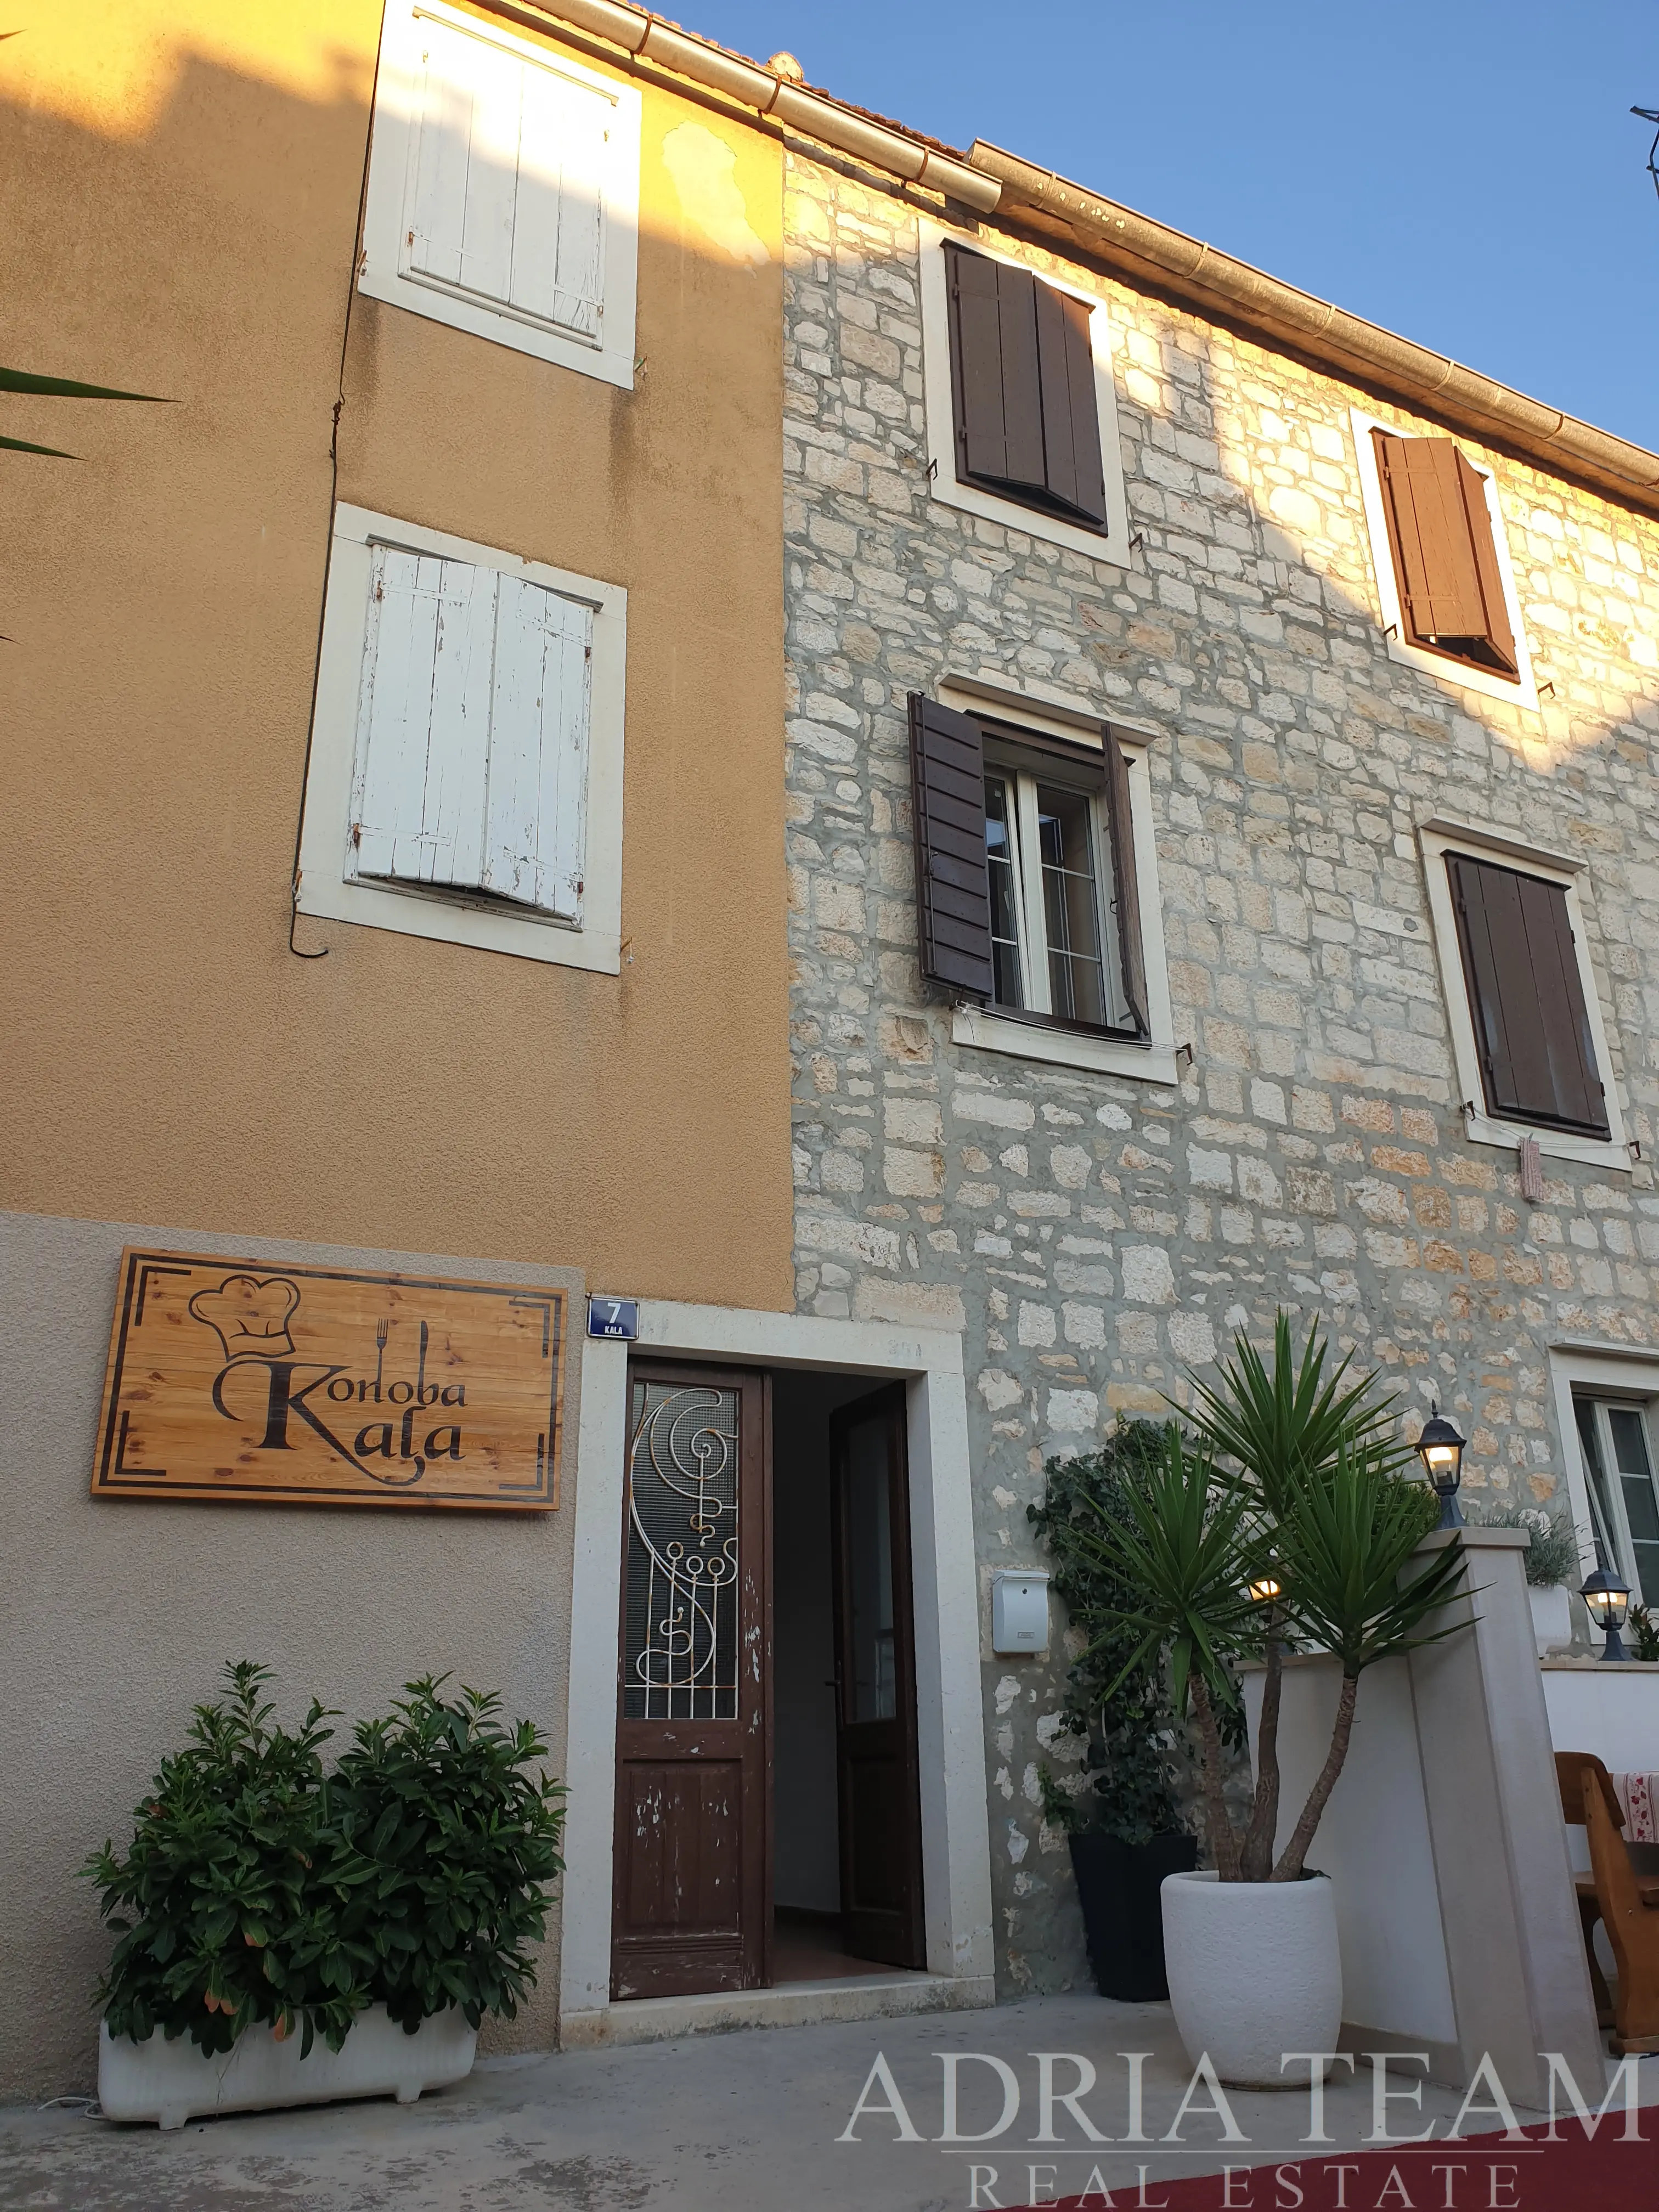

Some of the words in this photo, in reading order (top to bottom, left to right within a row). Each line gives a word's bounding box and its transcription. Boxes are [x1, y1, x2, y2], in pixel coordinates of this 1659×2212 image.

[607, 1302, 621, 1323] 7
[605, 1325, 623, 1335] KALA
[212, 1359, 469, 1451] Konoba
